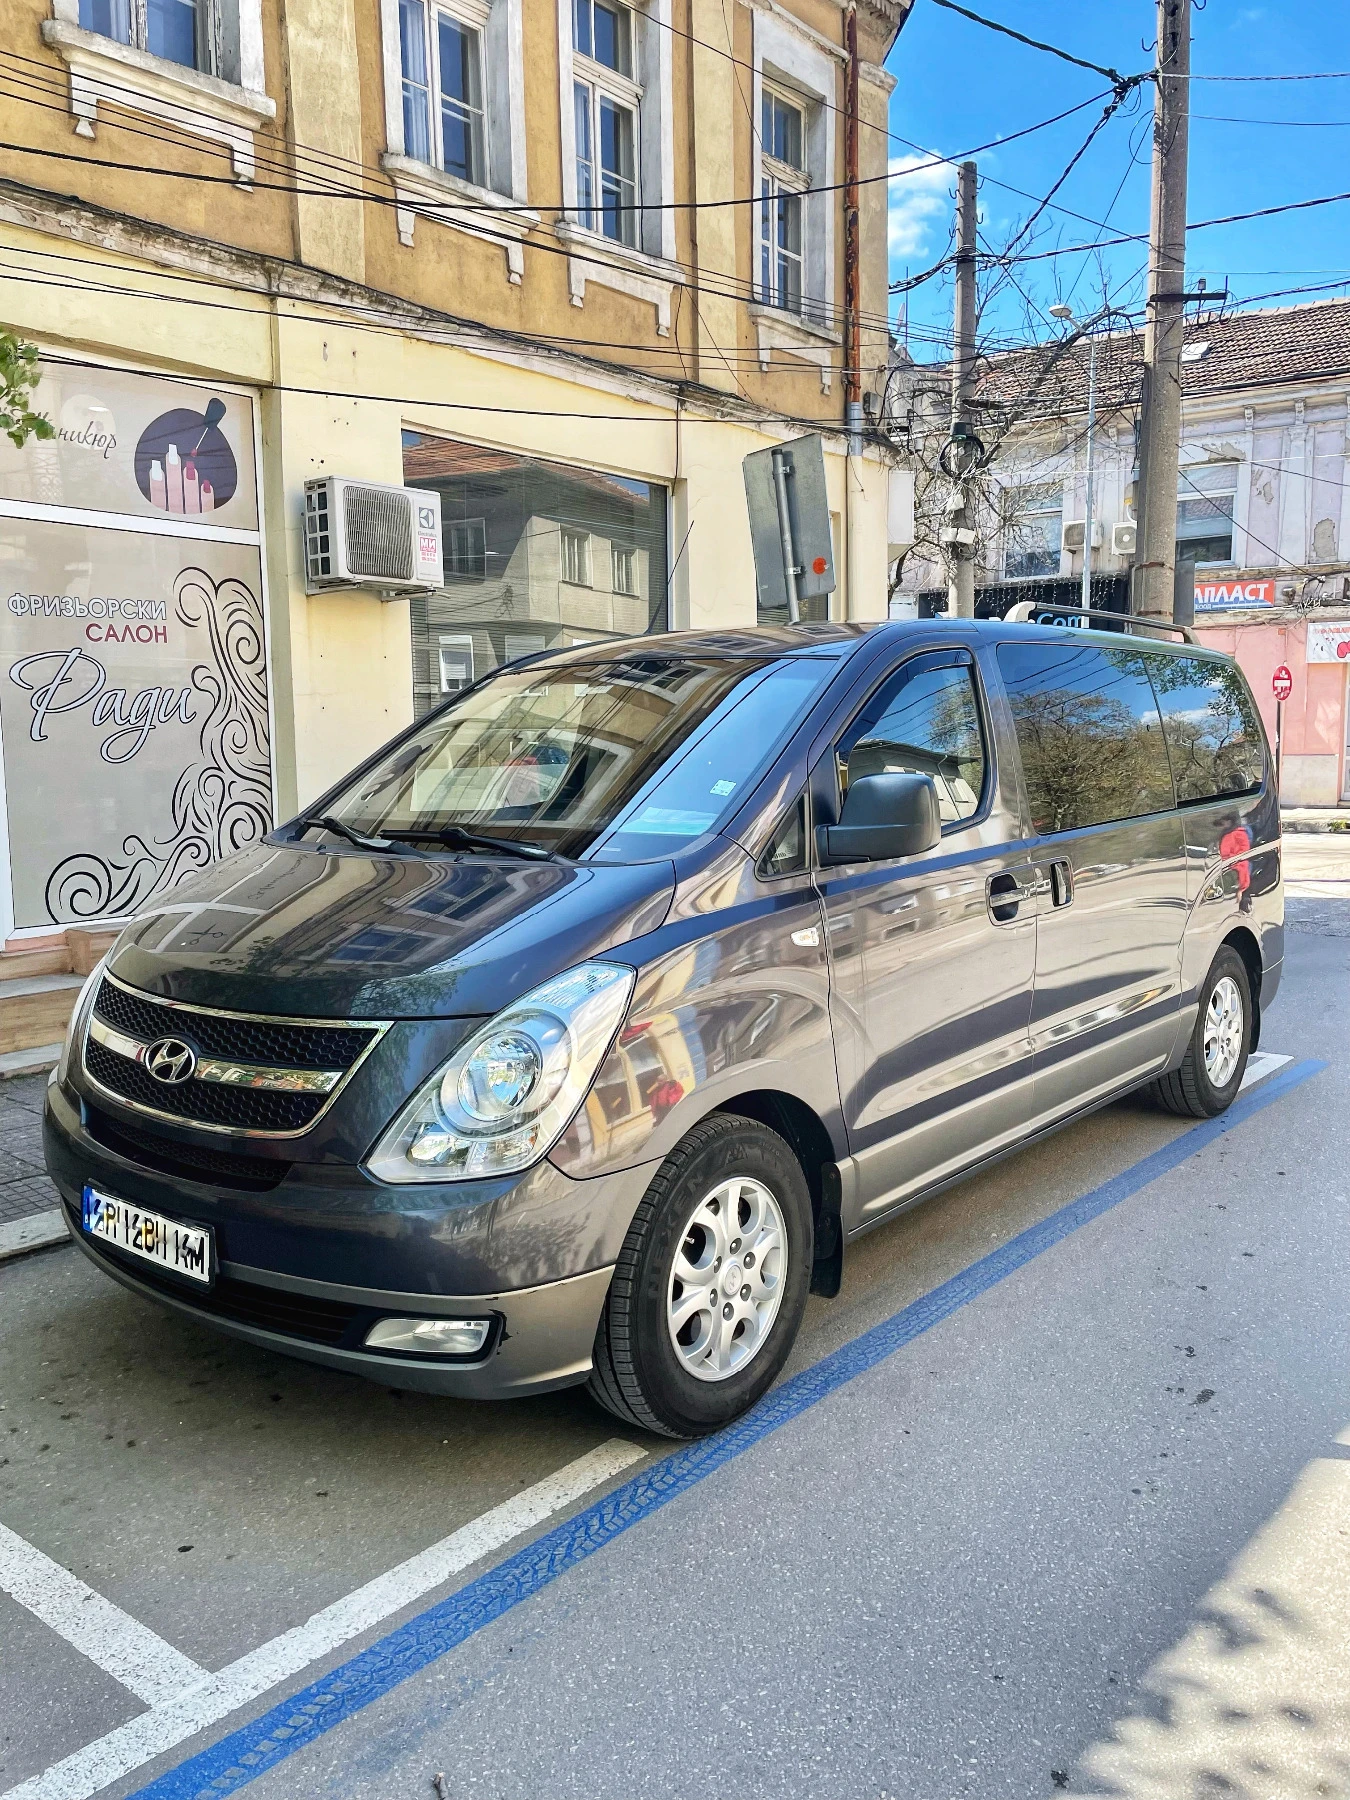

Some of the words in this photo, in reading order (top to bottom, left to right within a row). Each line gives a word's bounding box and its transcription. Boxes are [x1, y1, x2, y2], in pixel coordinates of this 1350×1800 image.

[7, 592, 167, 620] ФРИЗЬОРСКИ
[85, 623, 168, 643] САЛОН
[8, 647, 197, 764] Ради
